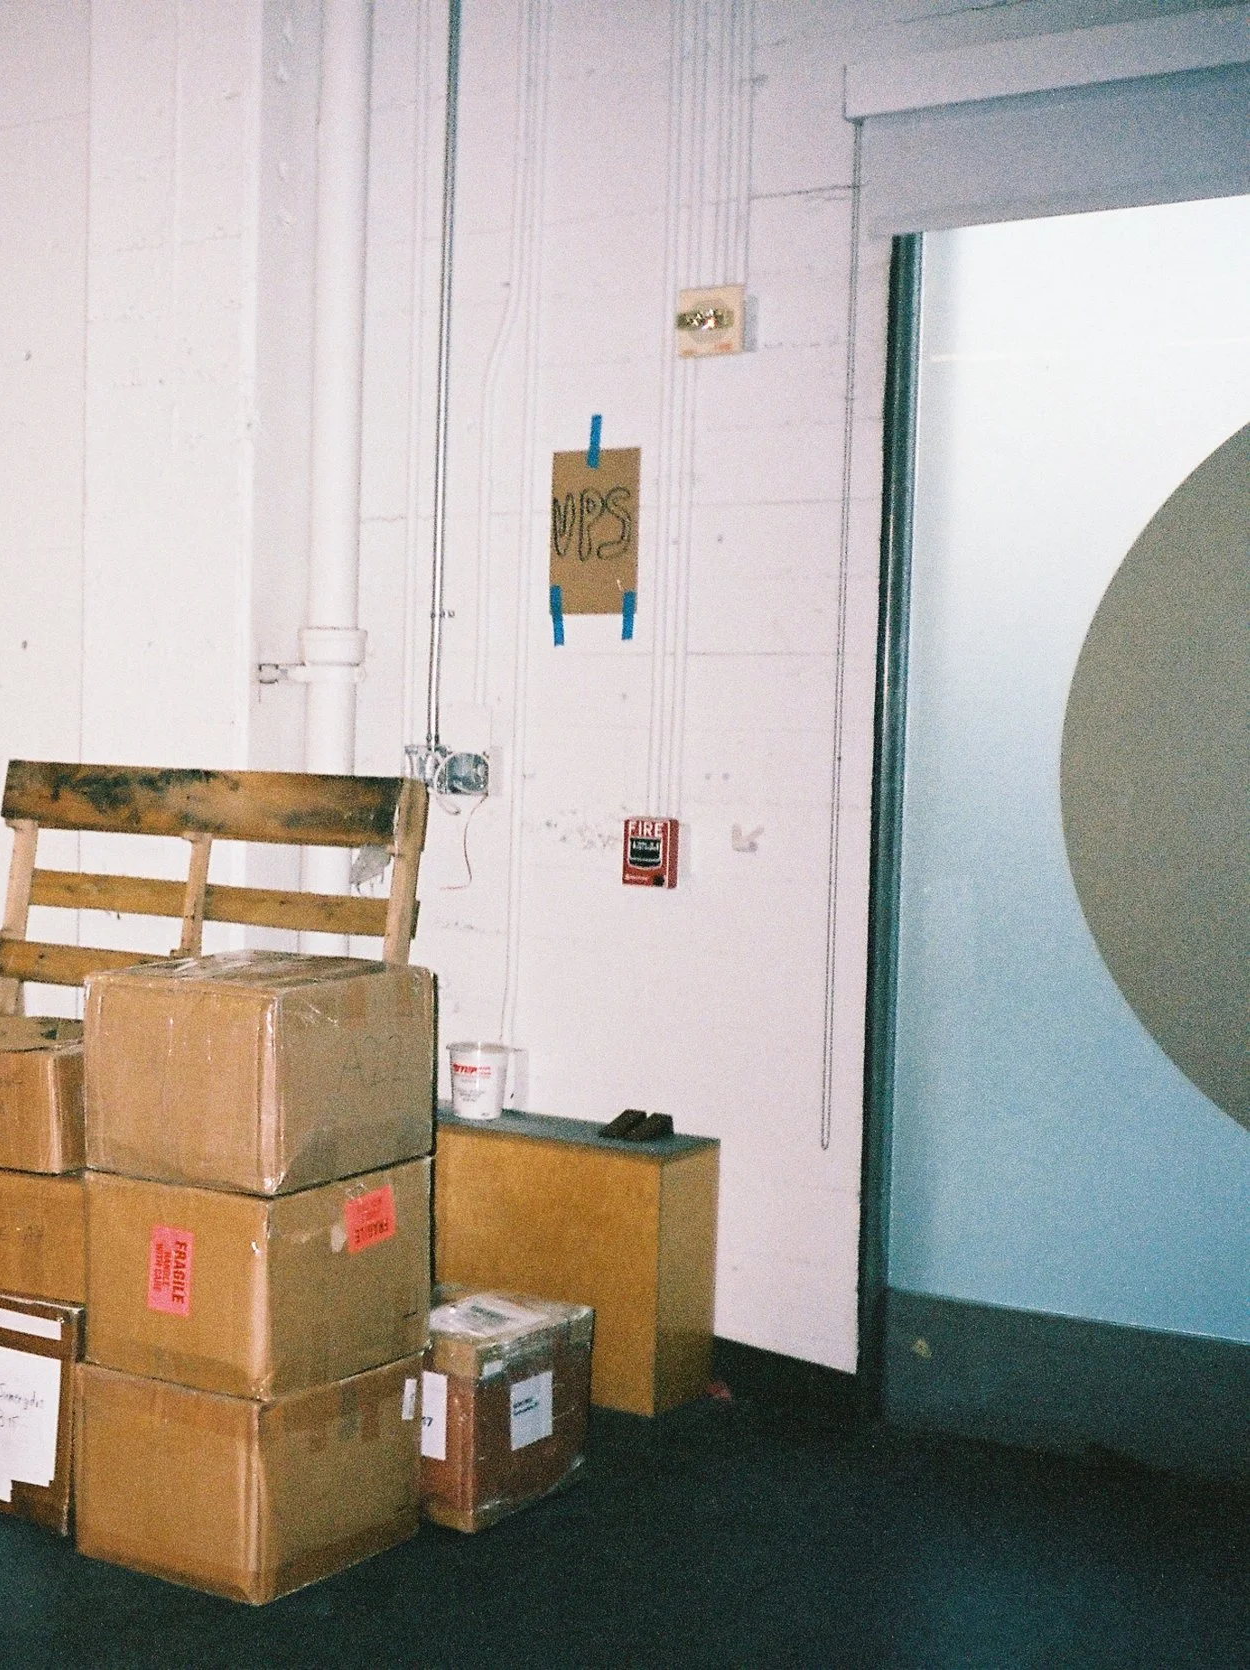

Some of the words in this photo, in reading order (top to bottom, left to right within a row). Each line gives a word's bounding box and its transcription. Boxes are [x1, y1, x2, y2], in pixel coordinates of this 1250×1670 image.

[552, 485, 632, 562] UPS
[629, 820, 664, 837] FIRE
[172, 1240, 188, 1304] FRAGILE
